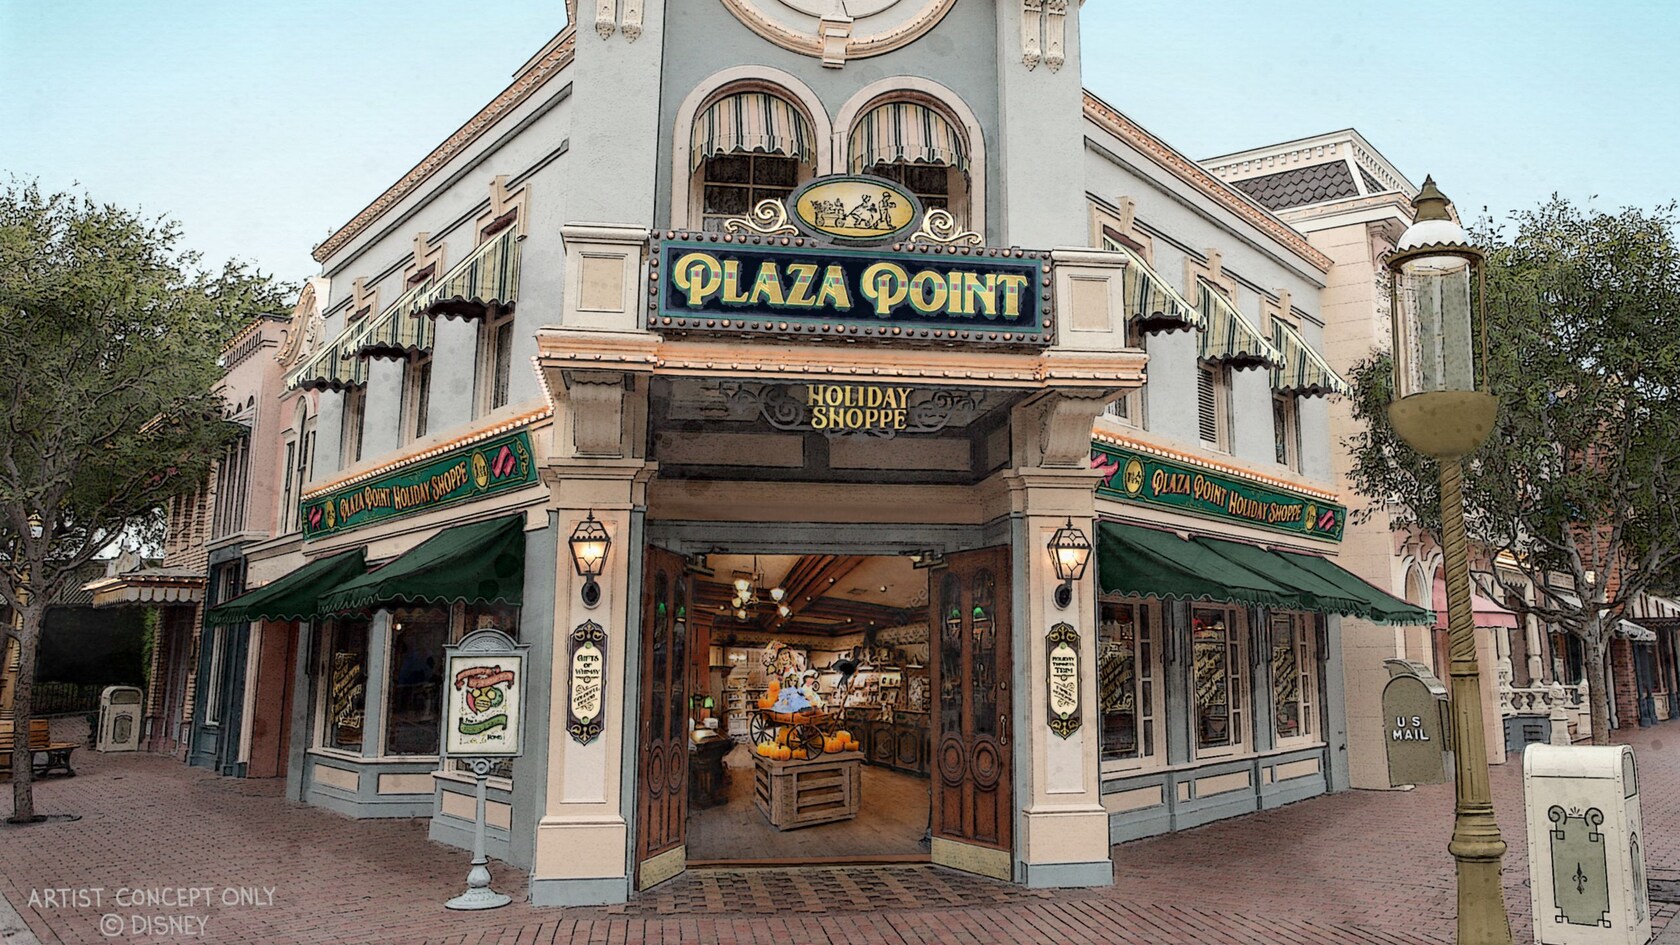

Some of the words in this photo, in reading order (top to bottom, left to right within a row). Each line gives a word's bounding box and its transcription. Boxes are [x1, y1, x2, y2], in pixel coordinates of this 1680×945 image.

[674, 252, 852, 308] PLAZA
[861, 261, 1029, 317] POINT
[806, 384, 914, 409] HOLIDAY
[811, 406, 908, 430] SHOPPE
[393, 482, 430, 509] HOLIDAY
[431, 461, 468, 499] SHOPPE
[1228, 490, 1269, 520] HOLIDAY
[1267, 501, 1304, 523] SHOPPE
[1396, 715, 1406, 728] U
[1411, 715, 1421, 728] S
[1392, 728, 1430, 741] MAIL
